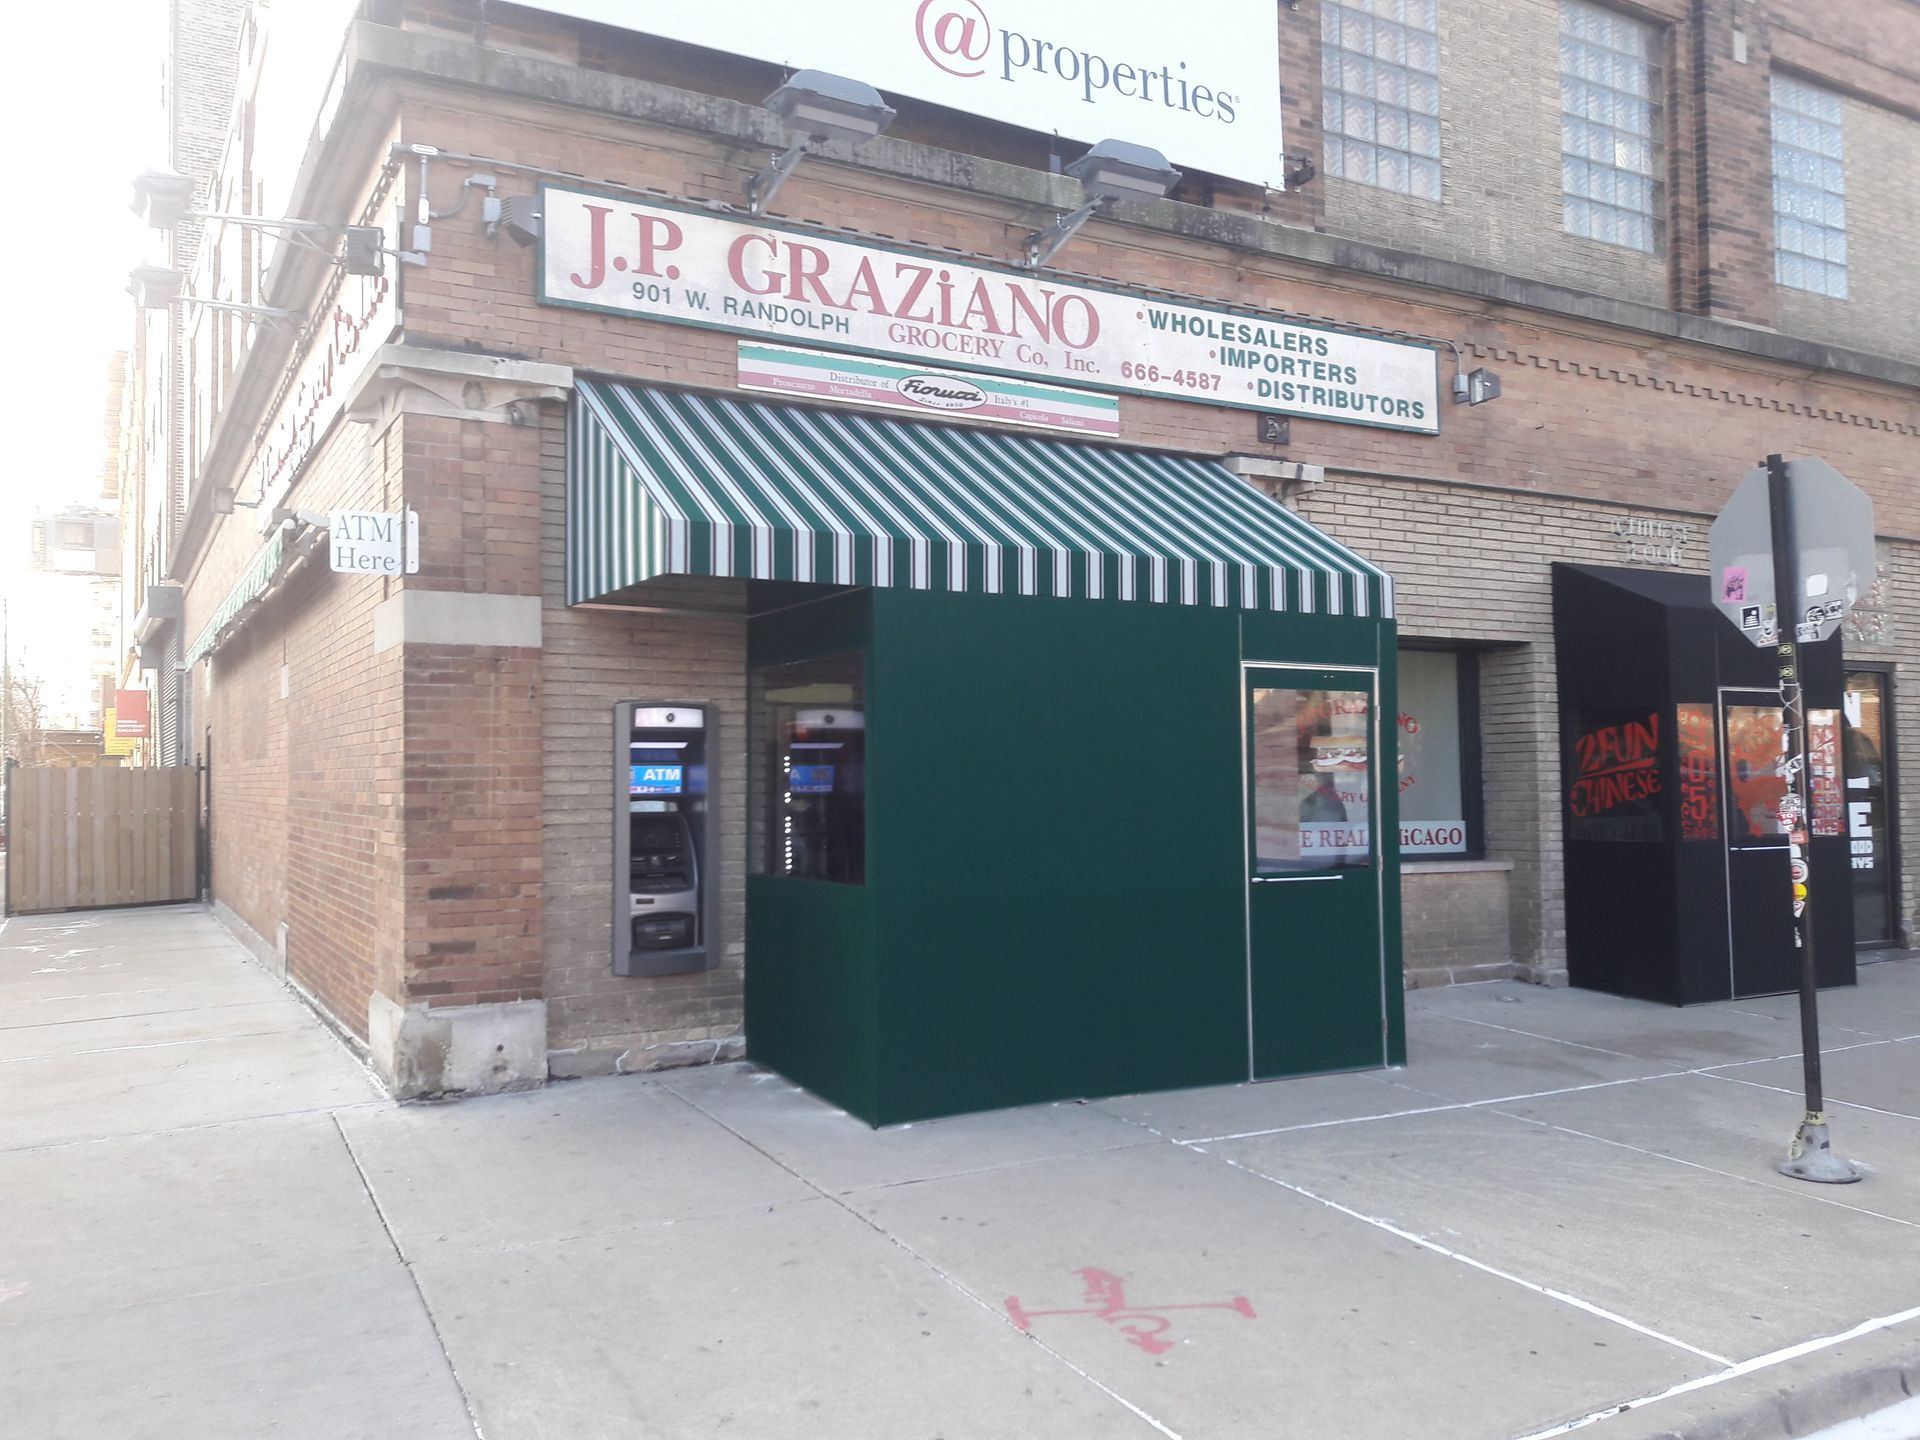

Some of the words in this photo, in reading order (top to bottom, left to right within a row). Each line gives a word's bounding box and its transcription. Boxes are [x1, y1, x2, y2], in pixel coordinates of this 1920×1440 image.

[569, 203, 684, 290] J.P.
[632, 281, 671, 305] 901
[685, 289, 711, 312] W.
[723, 295, 850, 334] RANDOLPH
[887, 323, 1004, 359] GROCERY
[1064, 350, 1101, 374] Inc.
[1148, 308, 1328, 357] WHOLESALERS
[829, 371, 878, 388] Distributor
[880, 379, 891, 389] of
[1120, 360, 1222, 392] 666-4587
[1220, 346, 1358, 386] IMPORTERS
[902, 378, 982, 402] Fiorucci
[1257, 378, 1425, 420] DISTRIBUTORS
[334, 513, 394, 544] ATM
[335, 545, 396, 573] Here
[643, 768, 681, 781] ATM
[1569, 769, 1661, 817] CHINESE
[1319, 829, 1369, 848] REAL
